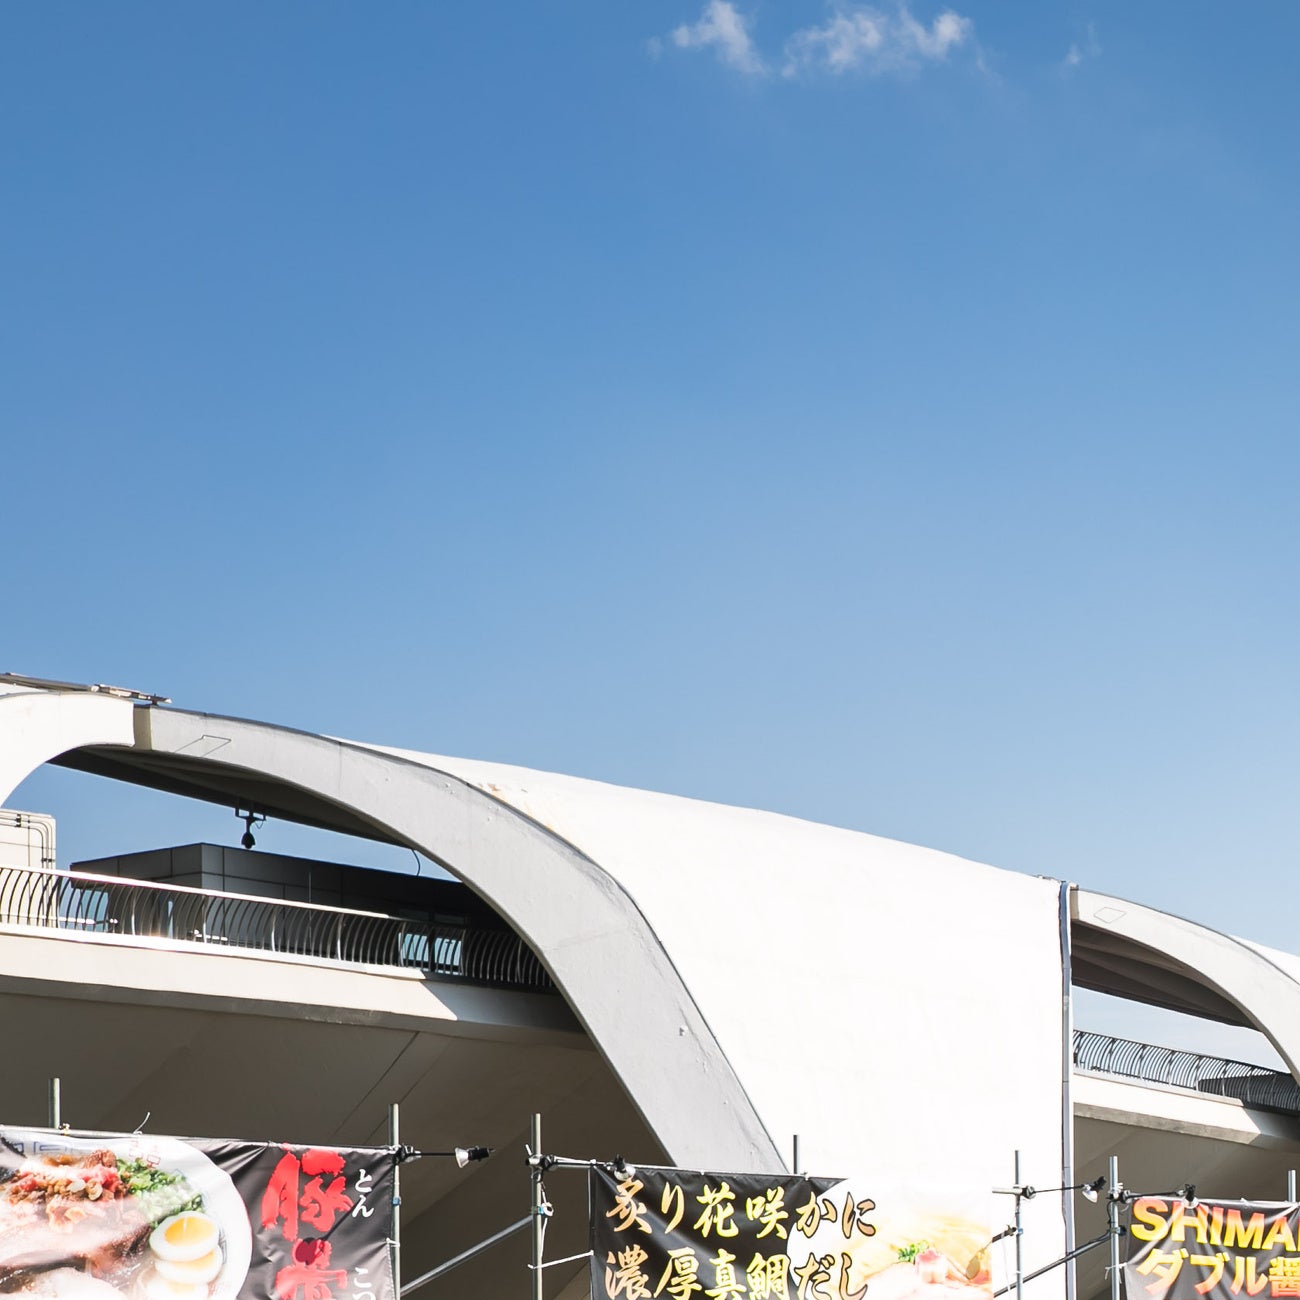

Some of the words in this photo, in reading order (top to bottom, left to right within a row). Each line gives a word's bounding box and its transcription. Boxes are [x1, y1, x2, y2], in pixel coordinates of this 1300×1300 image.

[351, 1168, 375, 1218] とん
[605, 1177, 876, 1240] 炙り花咲かに
